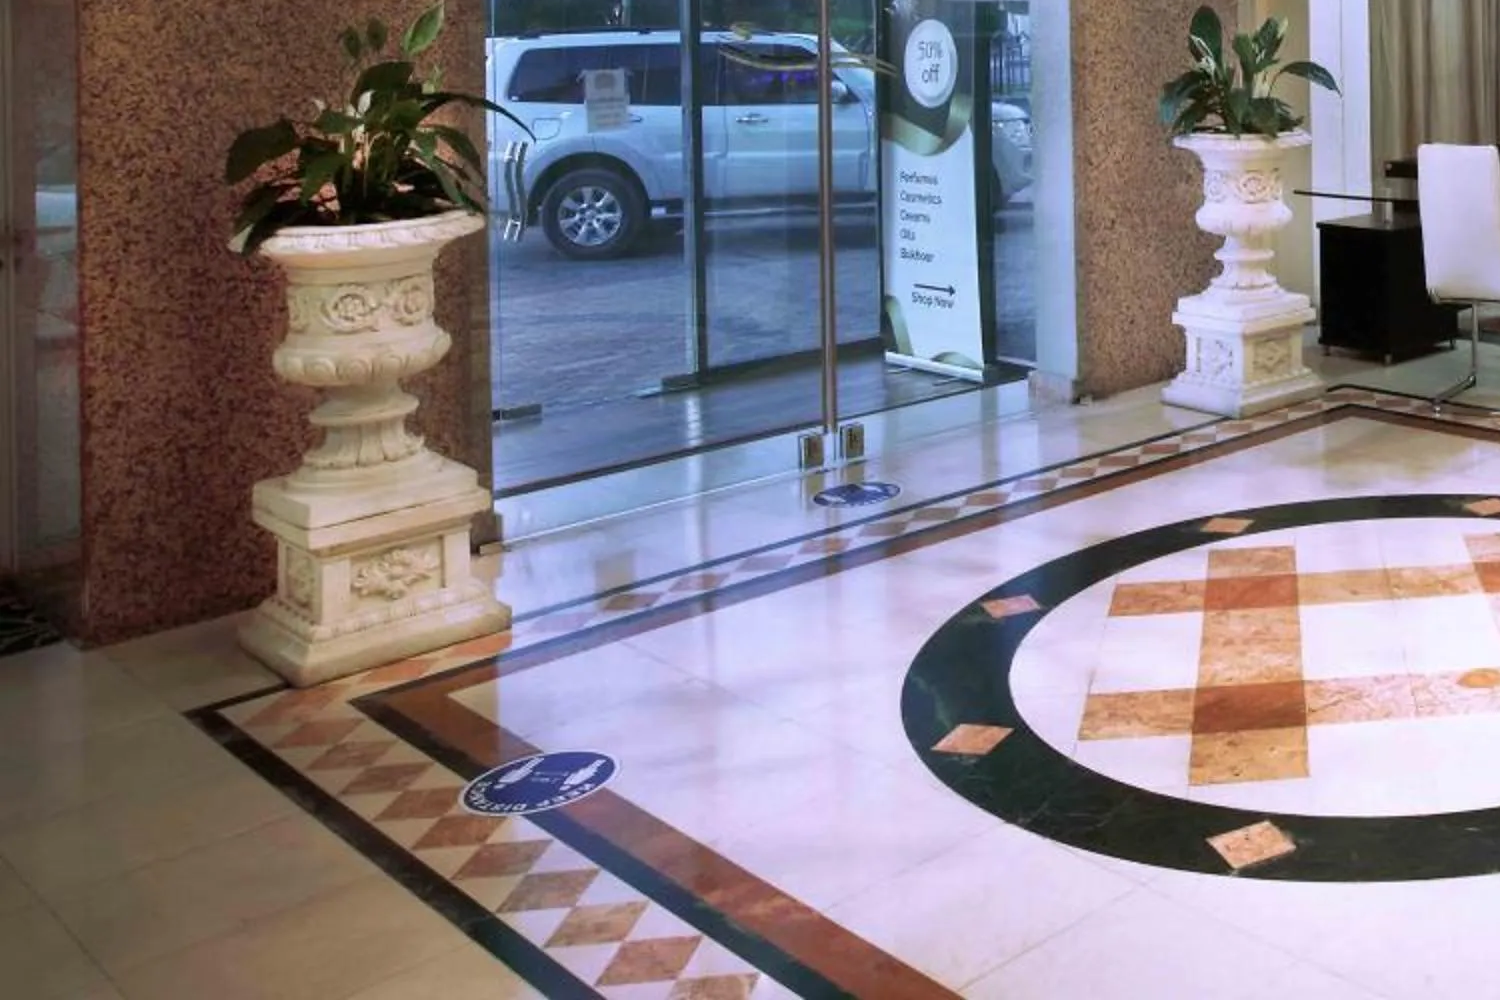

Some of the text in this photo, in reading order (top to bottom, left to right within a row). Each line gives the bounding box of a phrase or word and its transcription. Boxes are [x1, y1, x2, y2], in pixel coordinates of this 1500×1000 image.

[917, 39, 945, 61] 50%
[921, 63, 941, 84] off
[911, 291, 955, 310] Shop Now
[535, 782, 596, 808] KEEP
